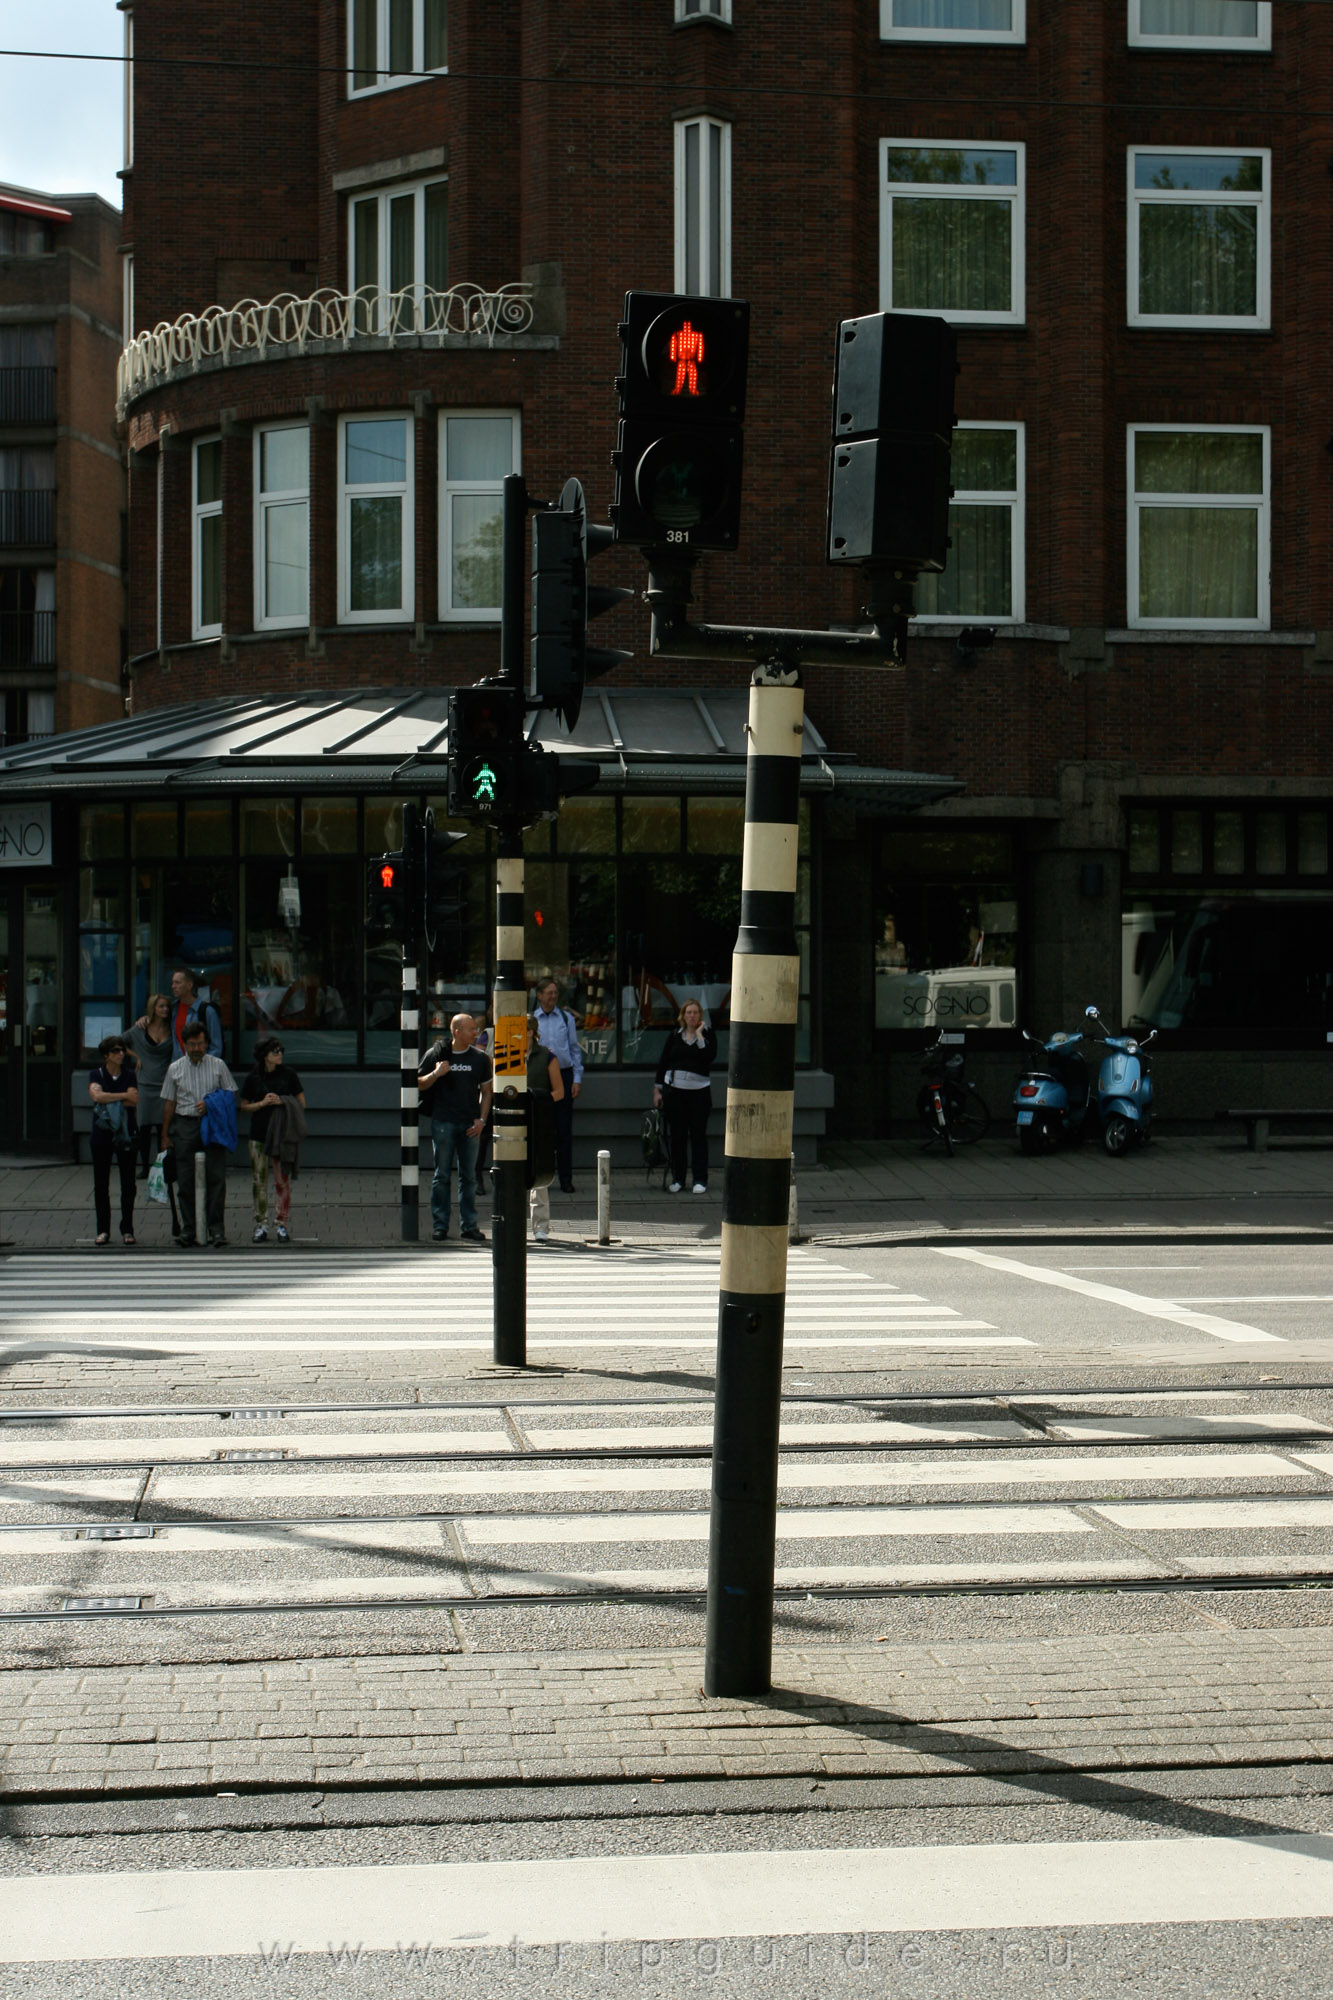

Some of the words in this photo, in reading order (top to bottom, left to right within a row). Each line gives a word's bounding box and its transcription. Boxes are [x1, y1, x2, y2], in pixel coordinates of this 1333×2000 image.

[666, 530, 690, 543] 381
[478, 802, 492, 811] 971
[903, 995, 989, 1016] SOGNO
[577, 1039, 608, 1055] NTE
[450, 1064, 472, 1072] didas
